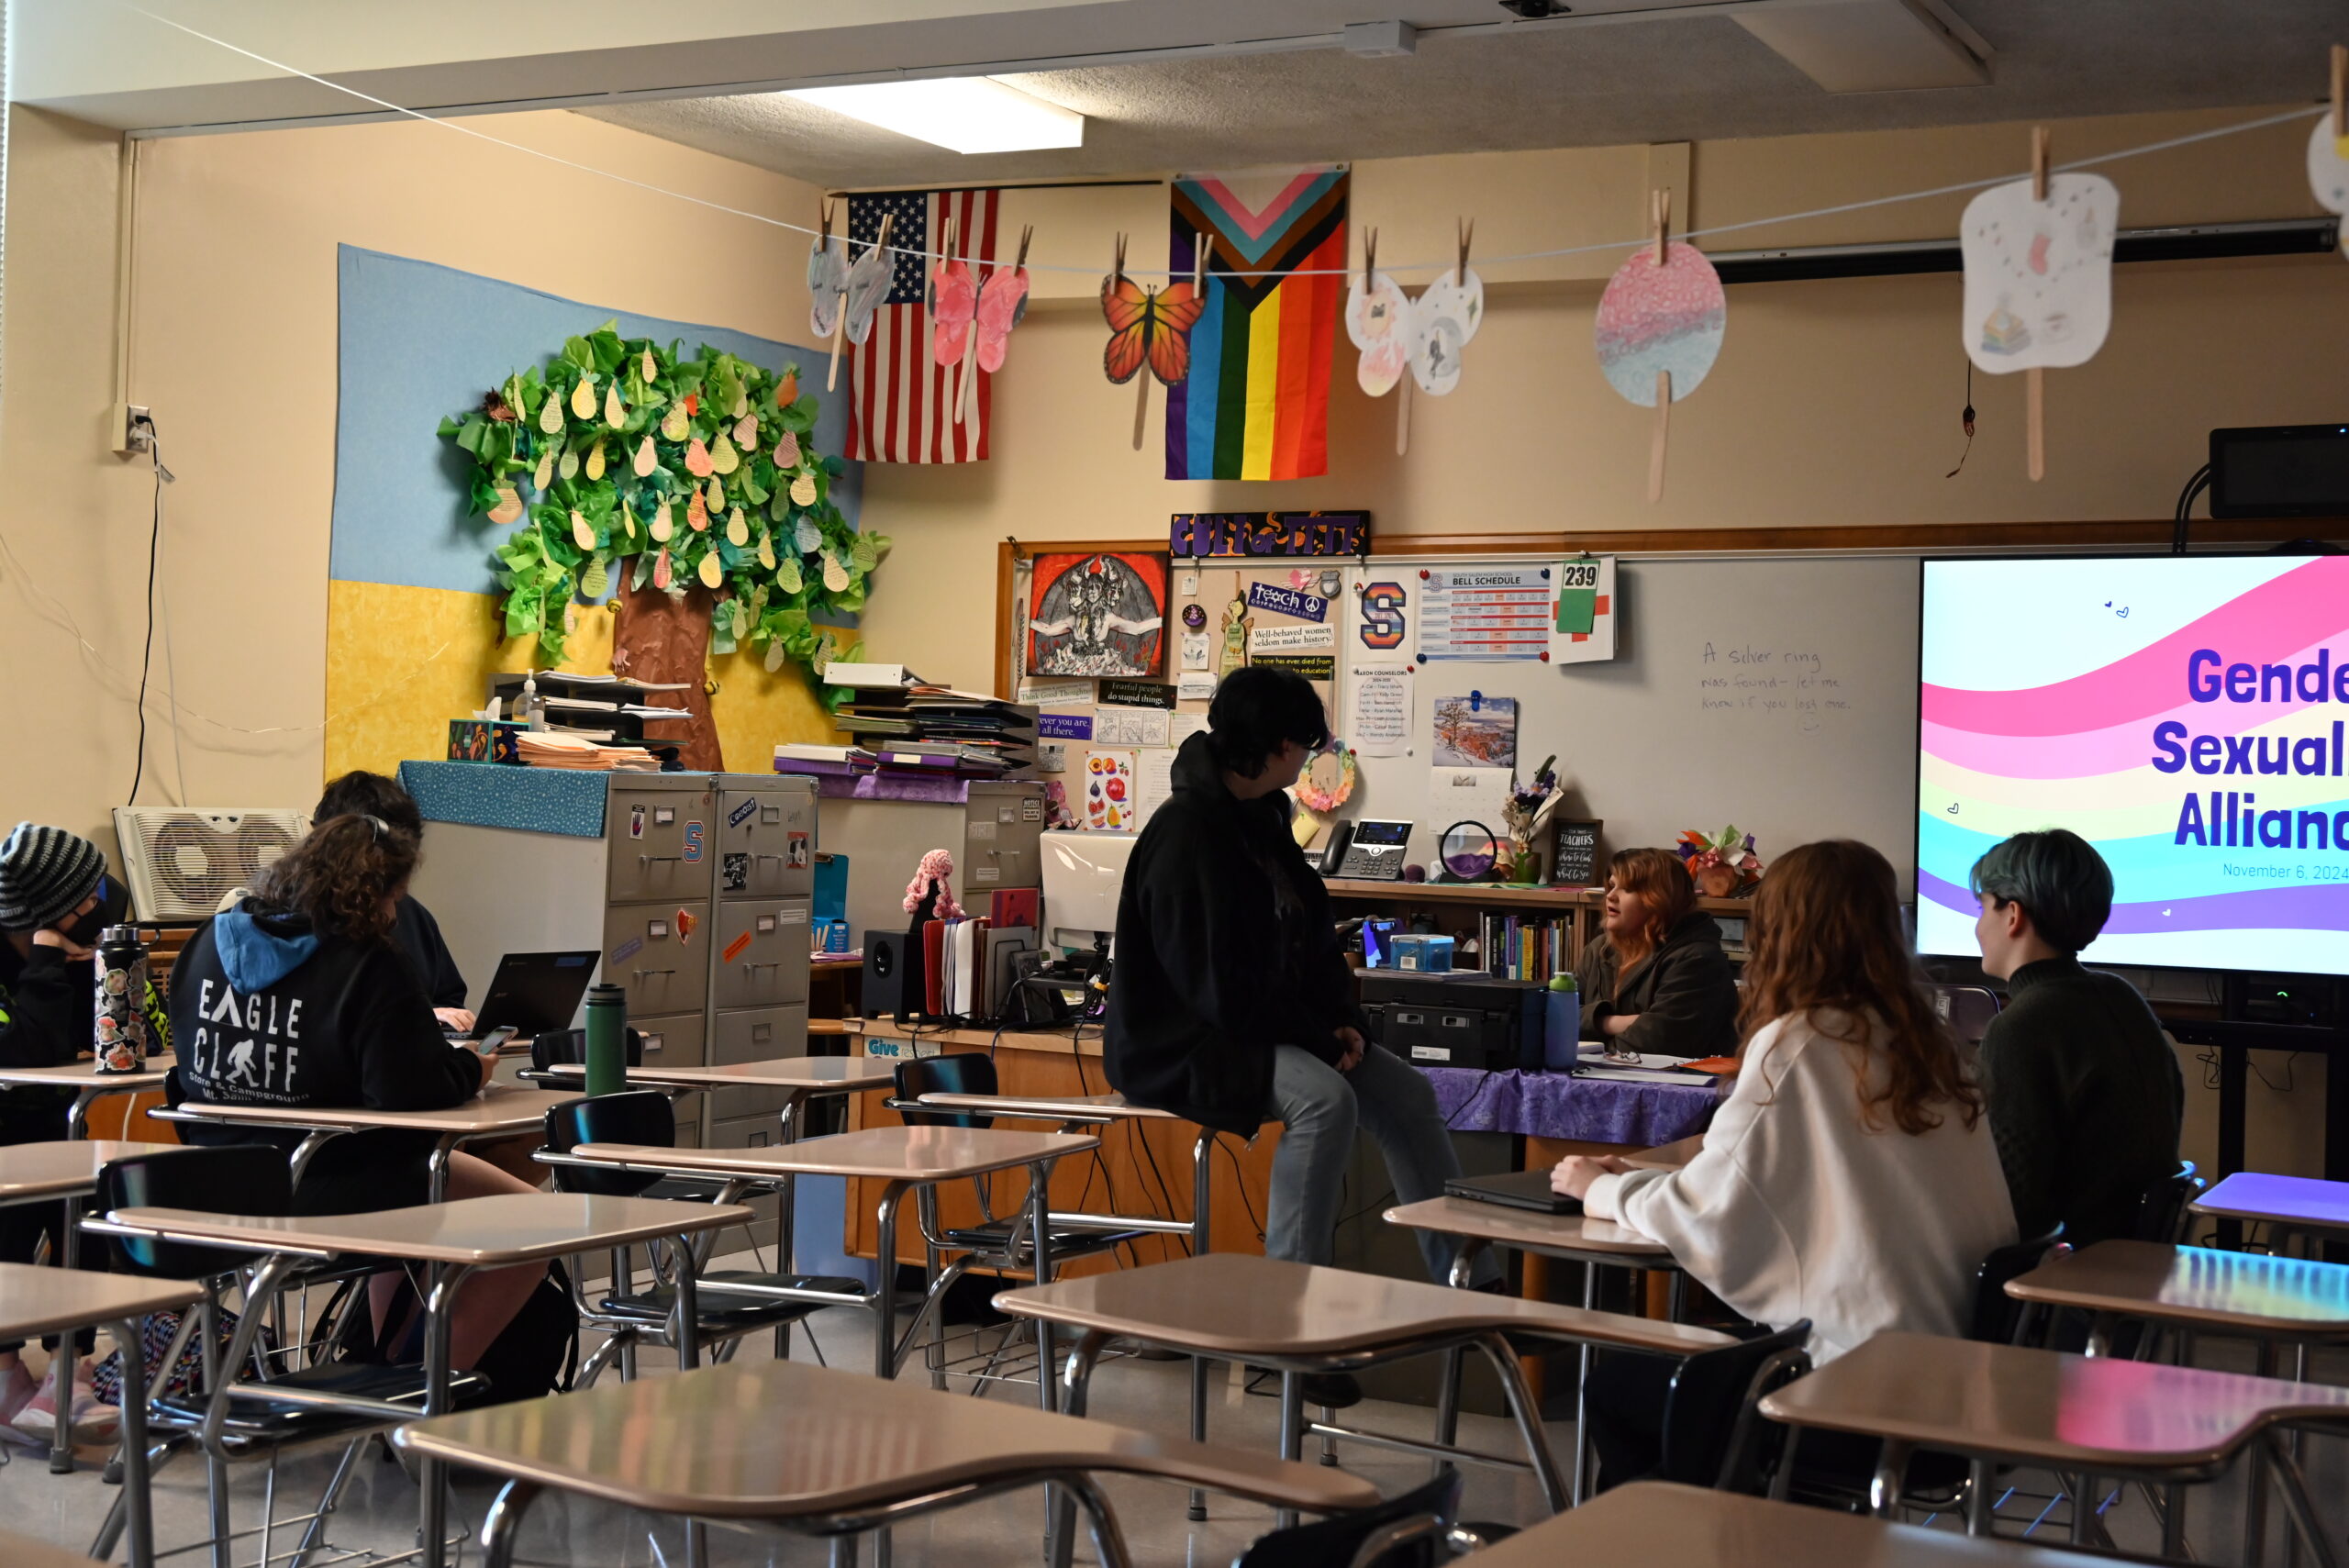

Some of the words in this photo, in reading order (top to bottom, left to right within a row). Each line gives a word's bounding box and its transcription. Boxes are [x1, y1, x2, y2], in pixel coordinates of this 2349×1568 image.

[1171, 516, 1247, 555] CULT
[1453, 577, 1473, 585] BELL
[1475, 576, 1520, 585] SCHEDULE
[1564, 566, 1597, 587] 239
[1254, 628, 1303, 639] Well-behaved
[1254, 638, 1280, 647] seldom
[1282, 637, 1302, 645] make
[1304, 635, 1331, 644] history.
[1703, 642, 1716, 664] A
[1729, 645, 1771, 664] silver
[1784, 651, 1821, 673] ring
[1797, 674, 1814, 688] let
[1821, 679, 1840, 687] me
[2188, 649, 2349, 705] Gende
[1021, 693, 1040, 701] Think
[1041, 691, 1058, 699] Good
[1112, 682, 1137, 691] Fearful
[1139, 684, 1163, 694] people
[1119, 694, 1140, 703] stupid
[1141, 694, 1165, 705] things.
[1742, 695, 1755, 709] if
[1763, 699, 1787, 715] you
[1795, 696, 1818, 710] lost
[1039, 717, 1057, 726] rever
[1041, 726, 1052, 734] all
[1053, 727, 1075, 737] there.
[2152, 720, 2349, 777] Sexual
[2174, 791, 2349, 851] Allianc
[1560, 834, 1594, 846] TEACHERS
[2223, 863, 2291, 878] November
[2296, 865, 2309, 882] 6,
[2313, 865, 2349, 880] 2024
[198, 978, 303, 1039] EAGLE
[868, 1038, 899, 1057] Give
[188, 1071, 211, 1087] Store
[216, 1082, 226, 1090] &
[203, 1087, 218, 1100] Mt.
